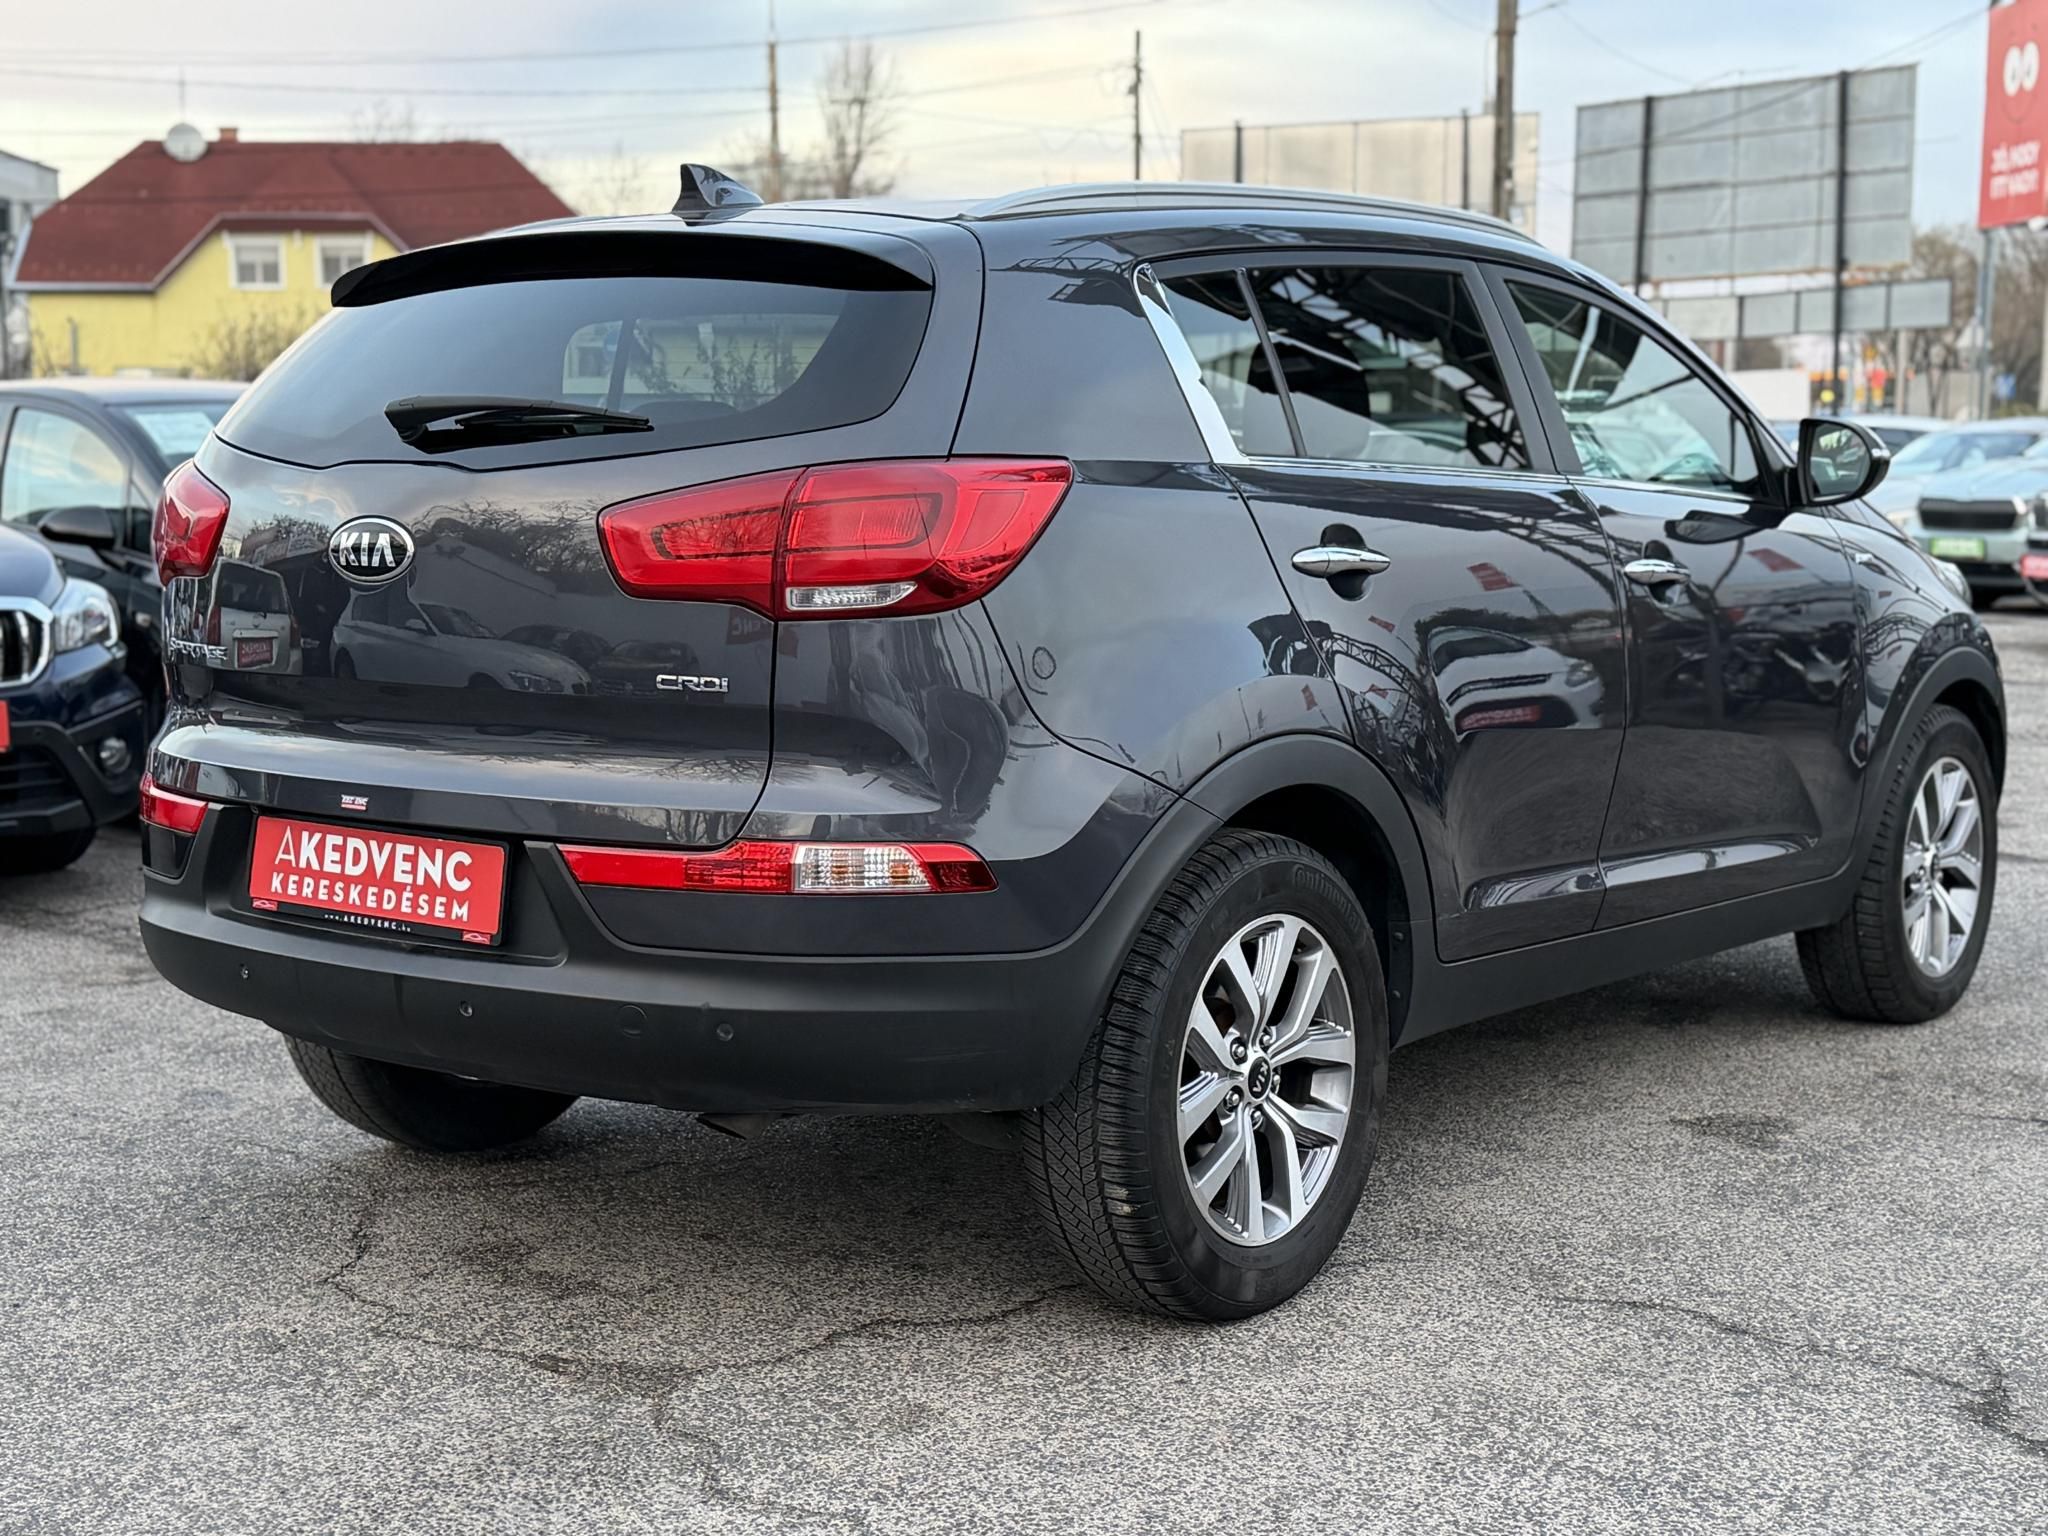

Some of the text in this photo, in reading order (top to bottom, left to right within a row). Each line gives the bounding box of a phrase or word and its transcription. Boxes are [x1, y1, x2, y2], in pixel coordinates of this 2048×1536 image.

[339, 531, 396, 567] KIA
[274, 825, 473, 892] AKEDVENC
[270, 871, 470, 922] KERESKEDÉSEM
[1252, 1061, 1269, 1092] KIA
